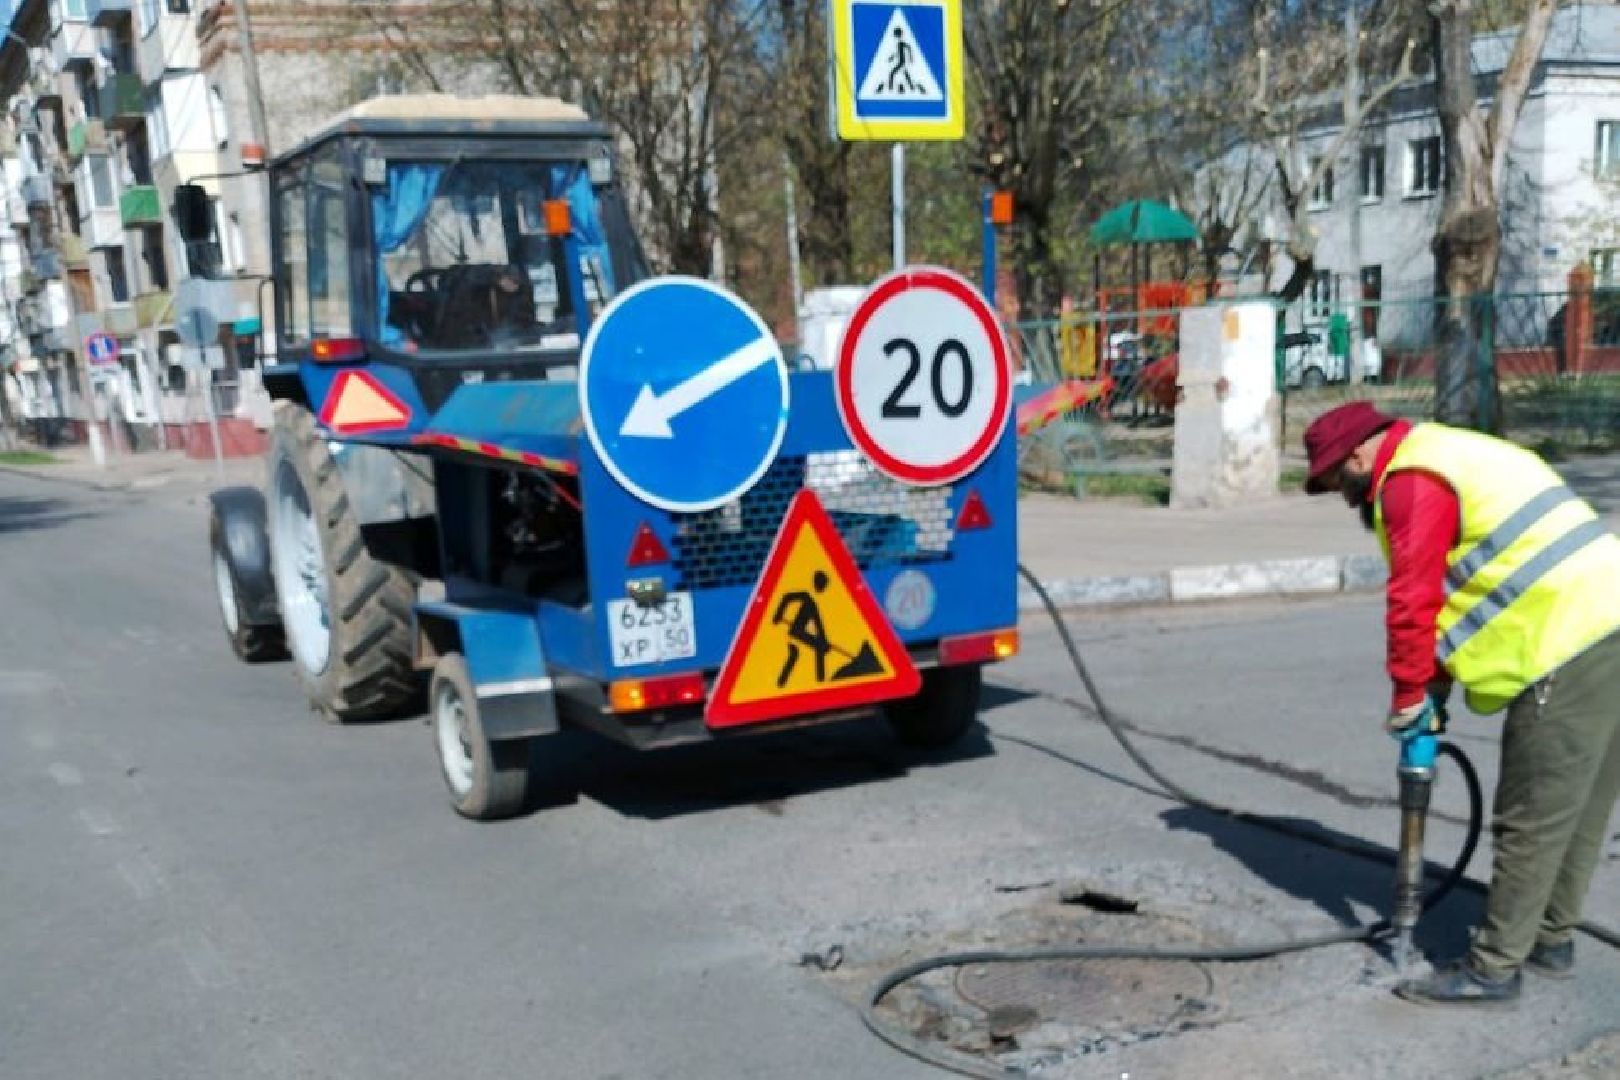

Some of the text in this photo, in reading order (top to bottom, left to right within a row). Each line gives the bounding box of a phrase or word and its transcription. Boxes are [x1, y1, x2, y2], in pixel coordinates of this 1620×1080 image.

[882, 338, 973, 418] 20
[895, 582, 926, 613] 20
[664, 628, 690, 648] 50
